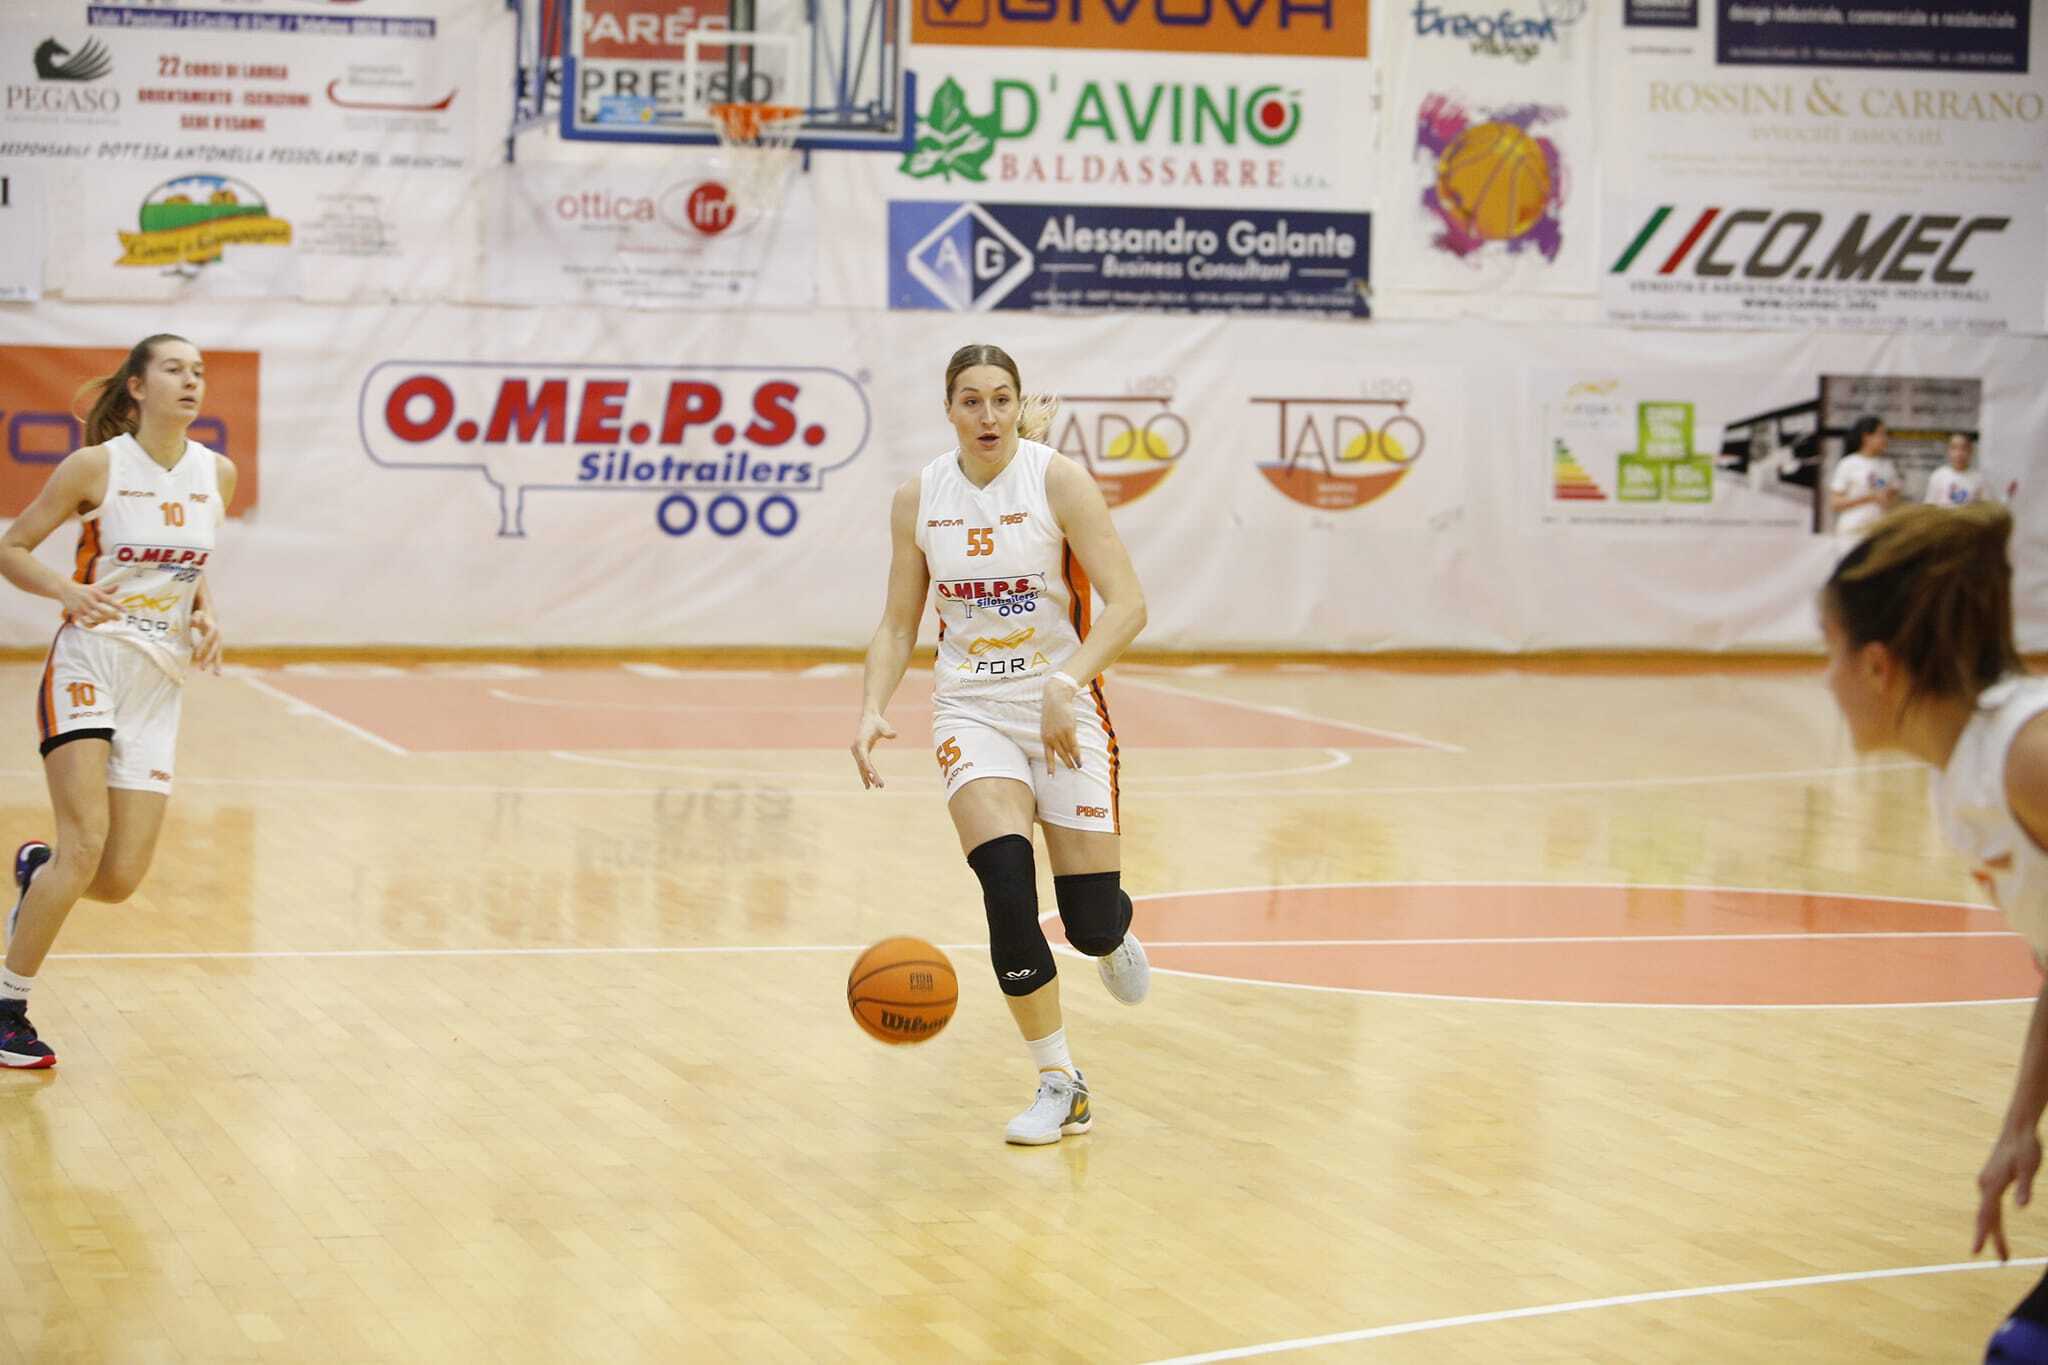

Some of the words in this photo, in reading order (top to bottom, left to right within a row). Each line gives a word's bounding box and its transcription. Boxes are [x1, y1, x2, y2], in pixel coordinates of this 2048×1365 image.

[159, 55, 181, 78] 22
[5, 84, 121, 112] PEGASO
[1647, 81, 1793, 114] ROSSINI
[1805, 75, 1848, 118] &
[1861, 87, 2045, 121] CARRANO
[174, 145, 263, 163] ANTONELLA
[1000, 153, 1284, 188] BALDASSARRE
[556, 190, 656, 222] ottica
[1037, 214, 1218, 258] Alessandro
[1227, 219, 1356, 260] Galante
[1694, 209, 2011, 285] CO.MEC
[1103, 258, 1182, 278] Business
[1187, 258, 1291, 282] Consultant
[384, 374, 827, 447] O.ME.P.S.
[1249, 397, 1426, 479] TADO
[577, 451, 813, 484] Silotrailers
[160, 501, 184, 528] 10
[966, 528, 994, 557] 55
[65, 681, 96, 707] 10
